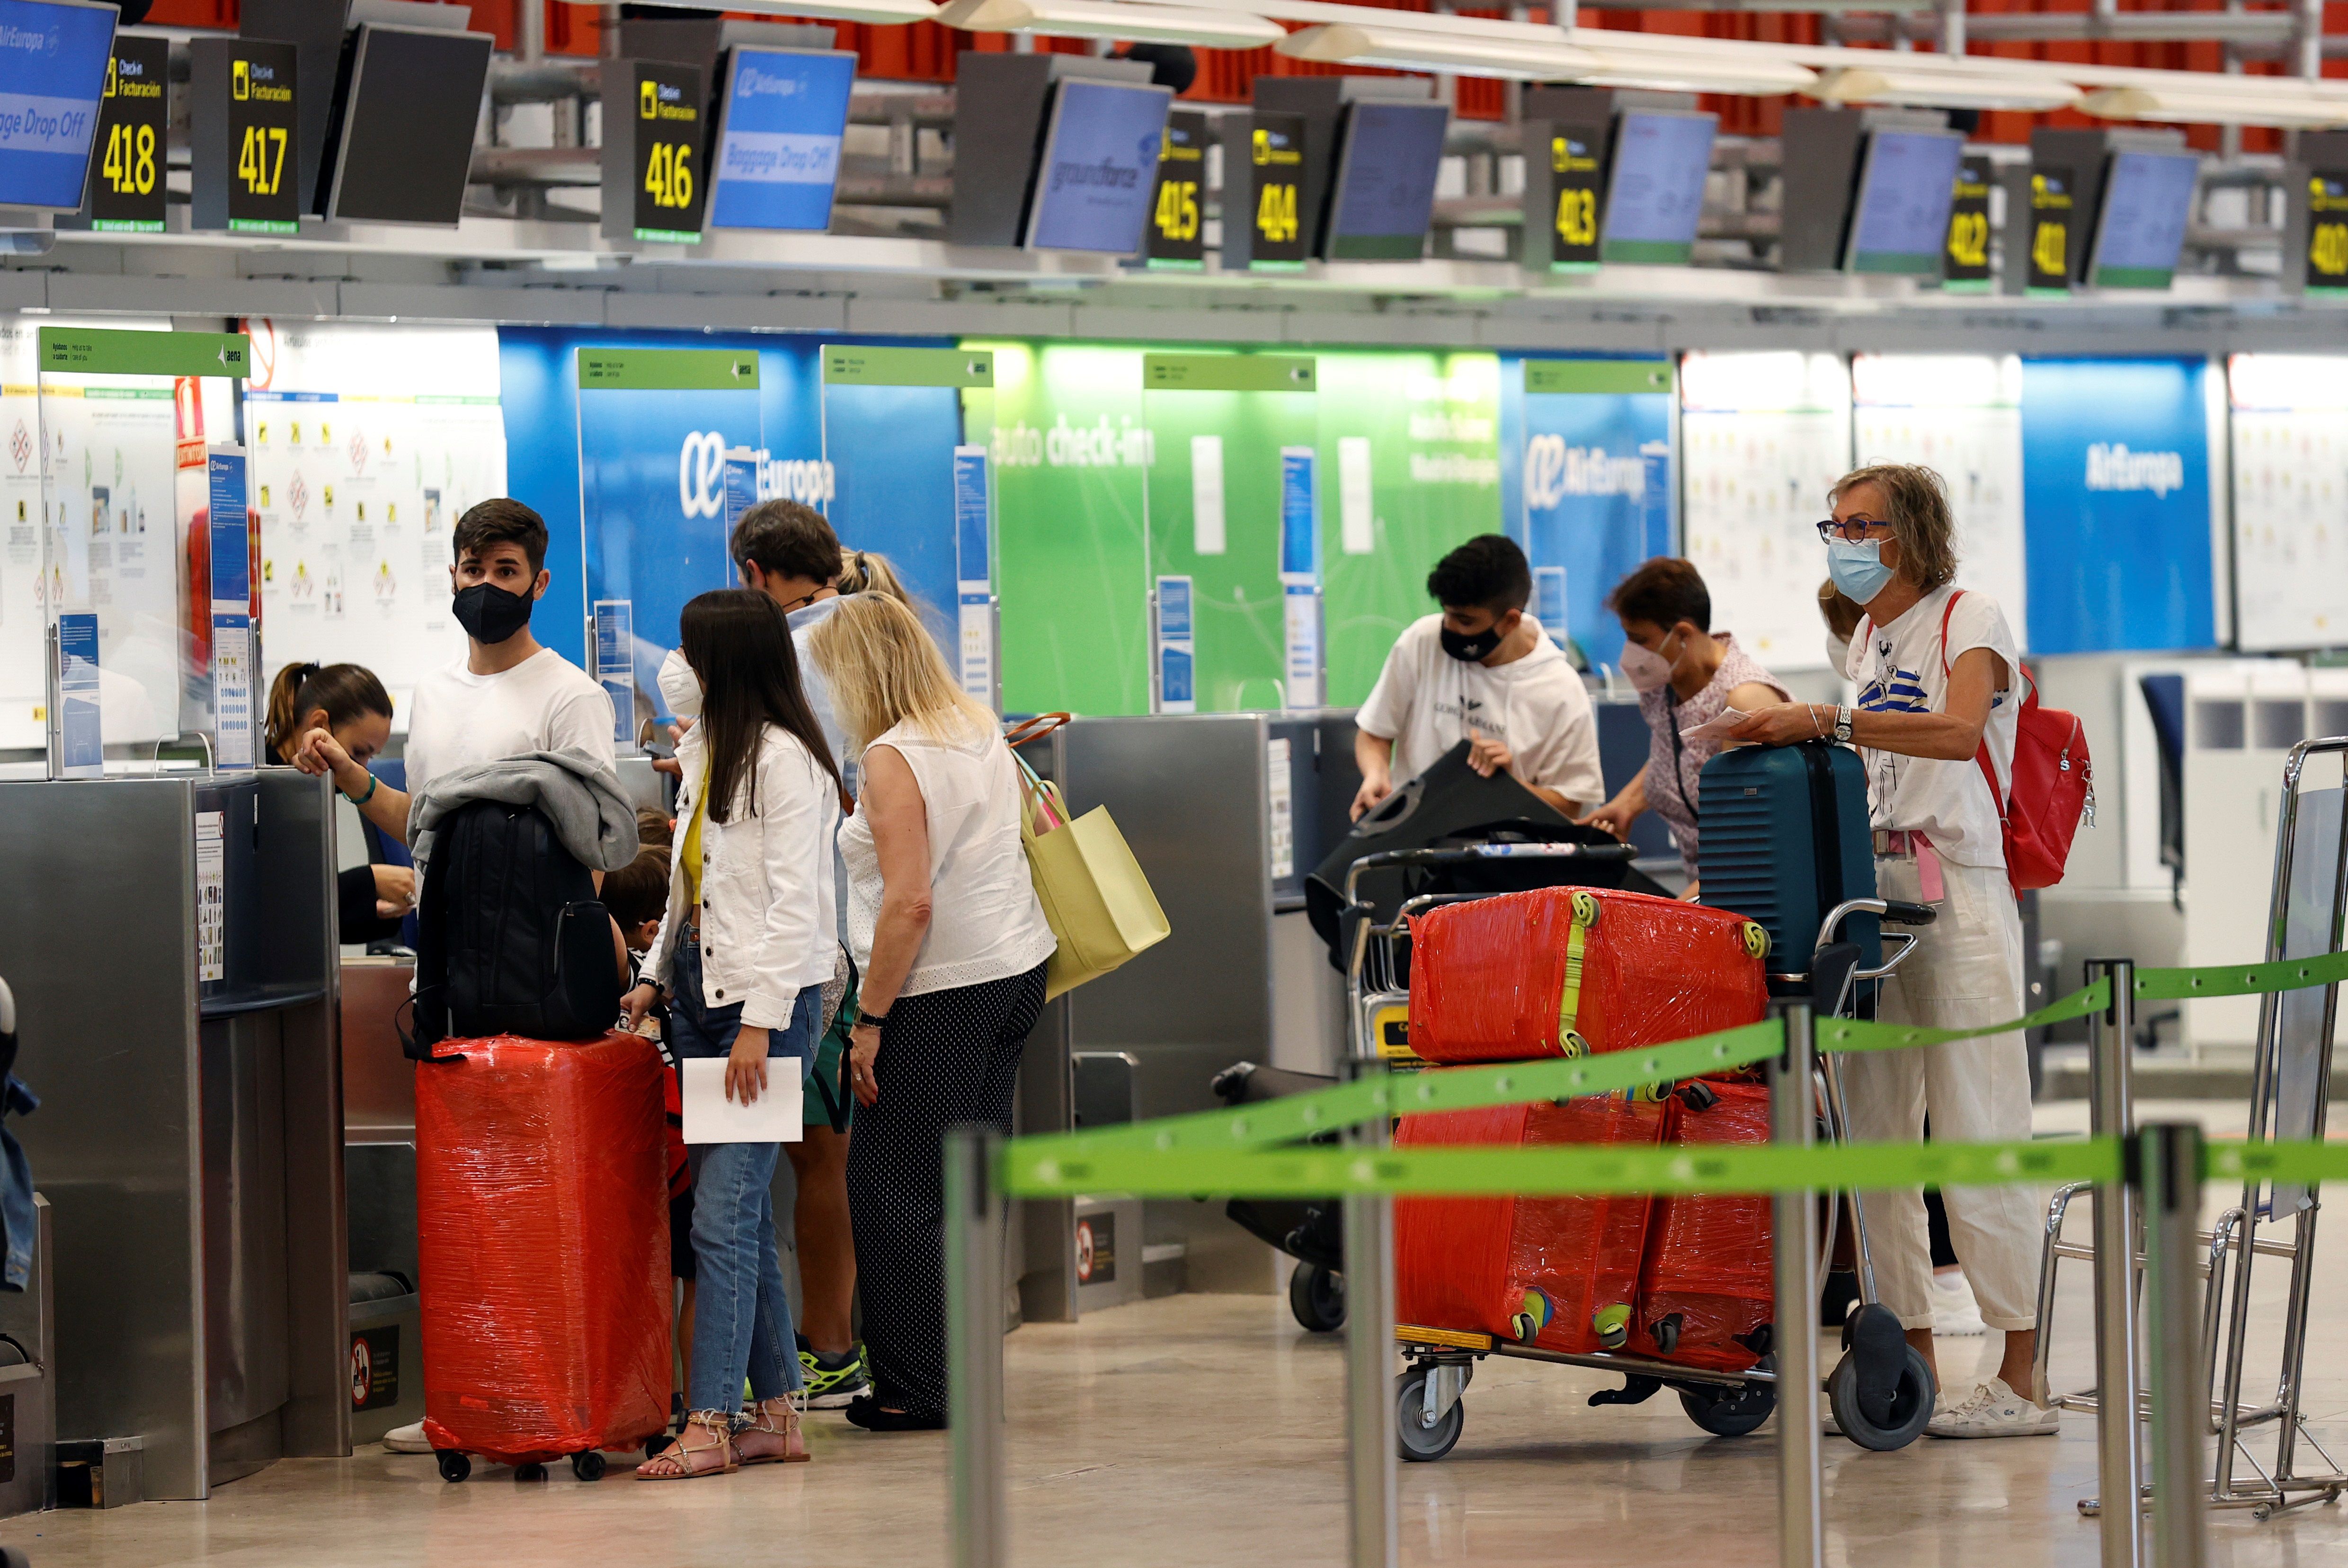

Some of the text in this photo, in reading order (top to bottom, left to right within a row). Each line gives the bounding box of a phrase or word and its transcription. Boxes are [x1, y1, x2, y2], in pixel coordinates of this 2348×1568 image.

[118, 79, 161, 98] Facturación
[25, 108, 57, 142] Drop
[61, 111, 86, 137] Off
[103, 124, 155, 195] 418
[239, 125, 288, 196] 417
[645, 142, 693, 209] 416
[727, 143, 778, 174] Baggage
[781, 144, 808, 171] Drop
[1155, 180, 1199, 241] 415
[1256, 183, 1298, 242] 414
[1556, 188, 1597, 246] 413
[227, 349, 240, 362] aena
[989, 412, 1156, 467] auto check-in
[2085, 442, 2184, 500] AirEuropa
[2060, 759, 2070, 771] S
